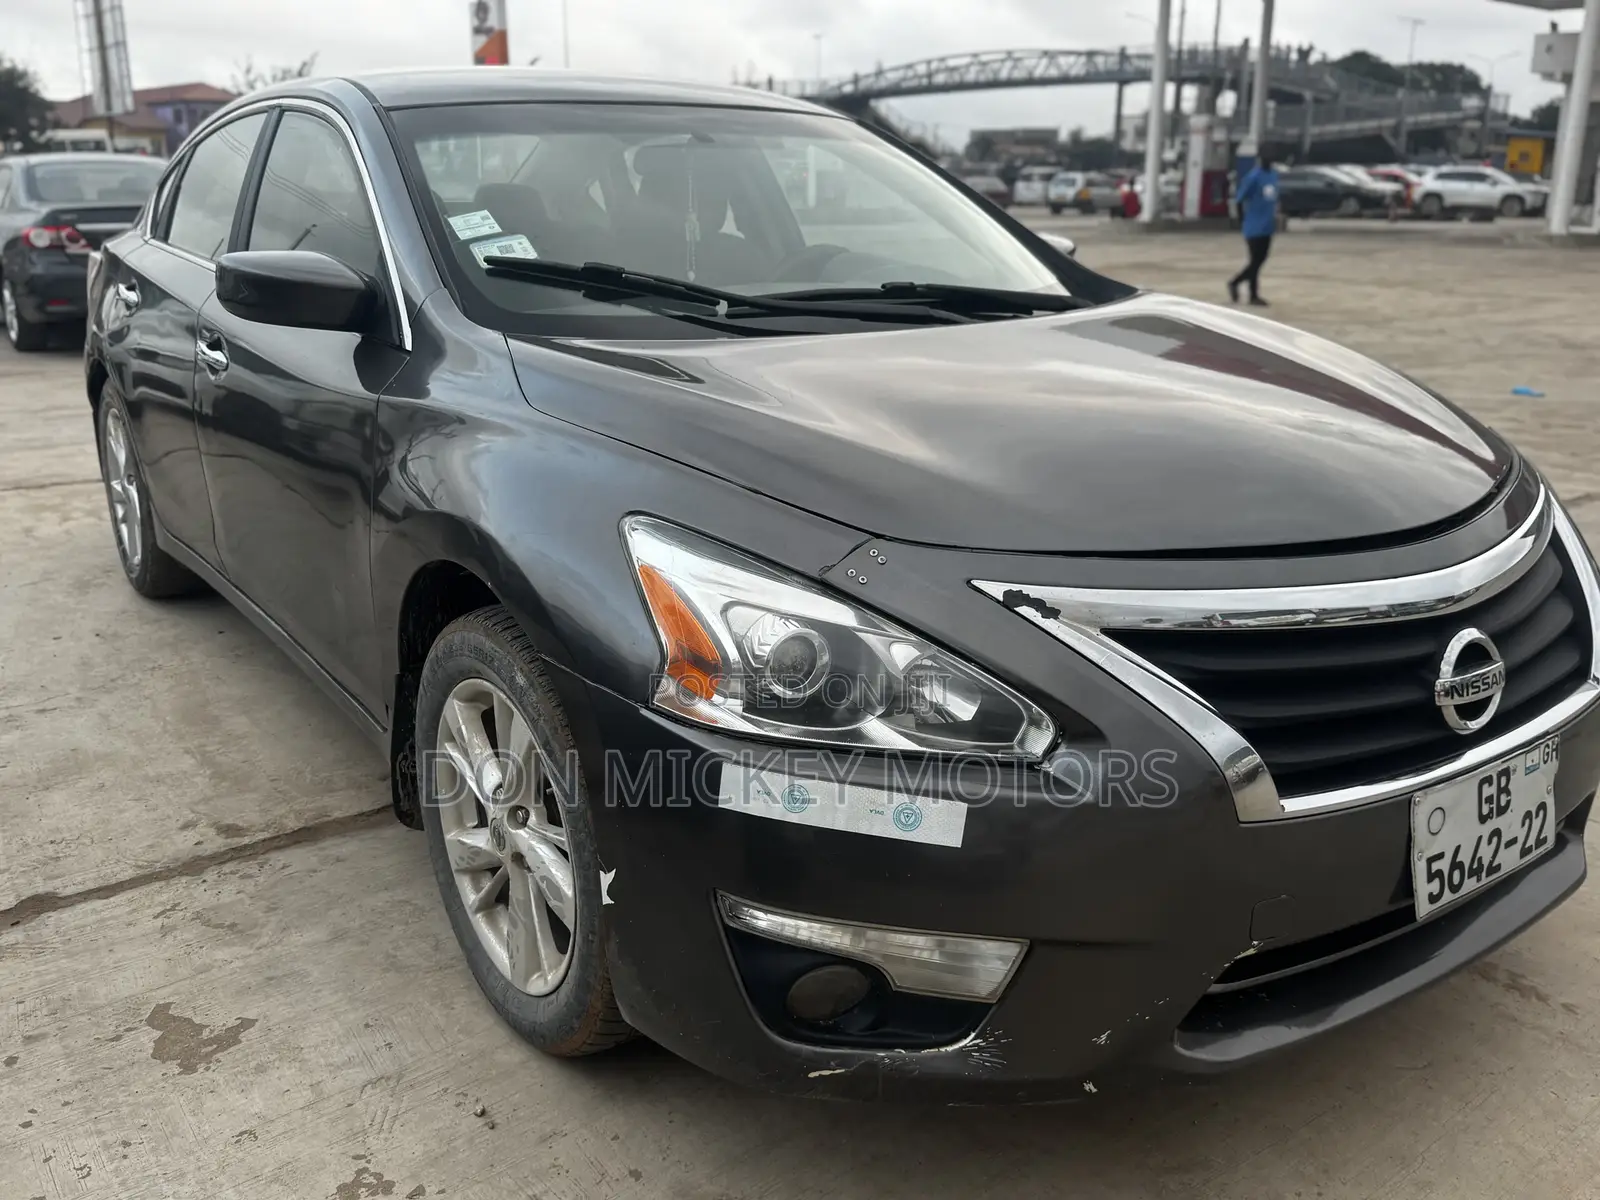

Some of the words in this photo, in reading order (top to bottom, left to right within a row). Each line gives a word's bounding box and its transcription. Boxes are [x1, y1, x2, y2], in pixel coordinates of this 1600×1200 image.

[1450, 669, 1504, 700] NISSAN
[1542, 738, 1559, 765] GH
[1477, 766, 1512, 825] GB
[1425, 801, 1548, 905] 5642-22
